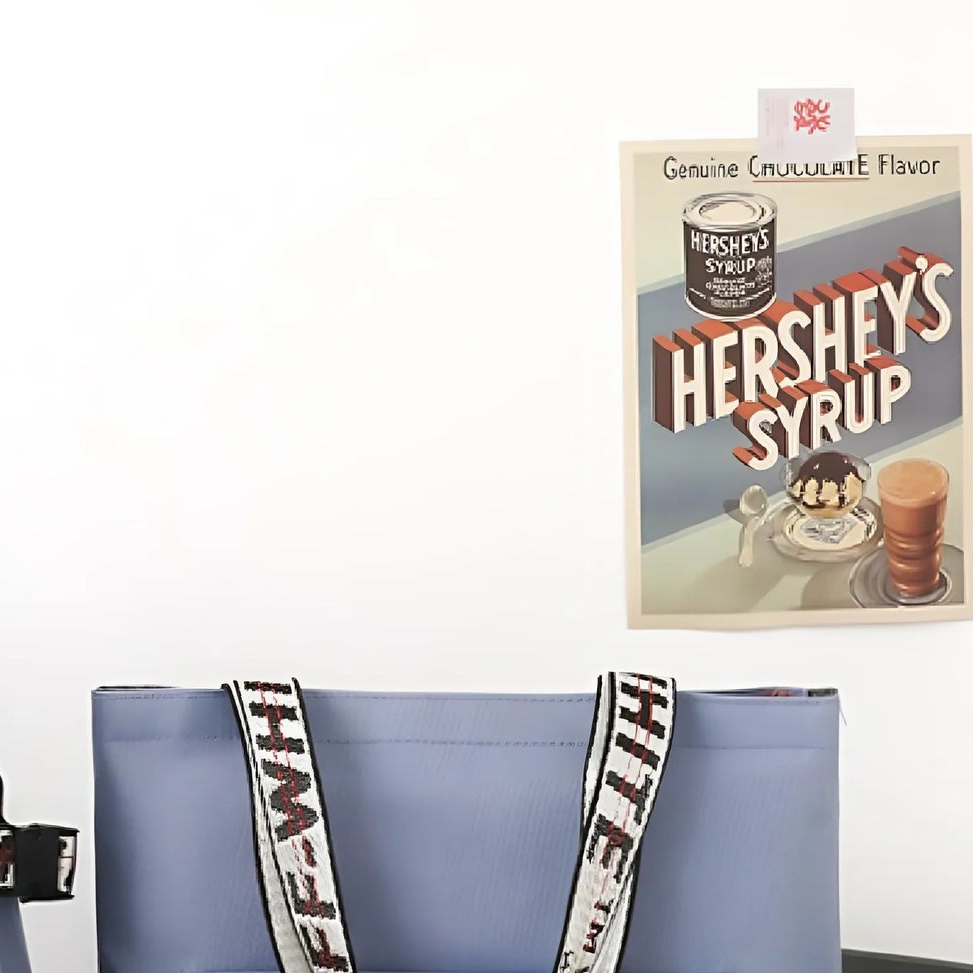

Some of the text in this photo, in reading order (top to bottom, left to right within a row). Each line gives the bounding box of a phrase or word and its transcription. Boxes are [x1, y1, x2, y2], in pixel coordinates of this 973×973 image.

[663, 155, 739, 180] Genuine
[878, 153, 941, 177] Flavor
[691, 227, 770, 257] HERSHEY'S
[705, 257, 756, 274] SYRUP
[657, 249, 955, 434] HERSHEY'S
[738, 360, 912, 471] SYRUP
